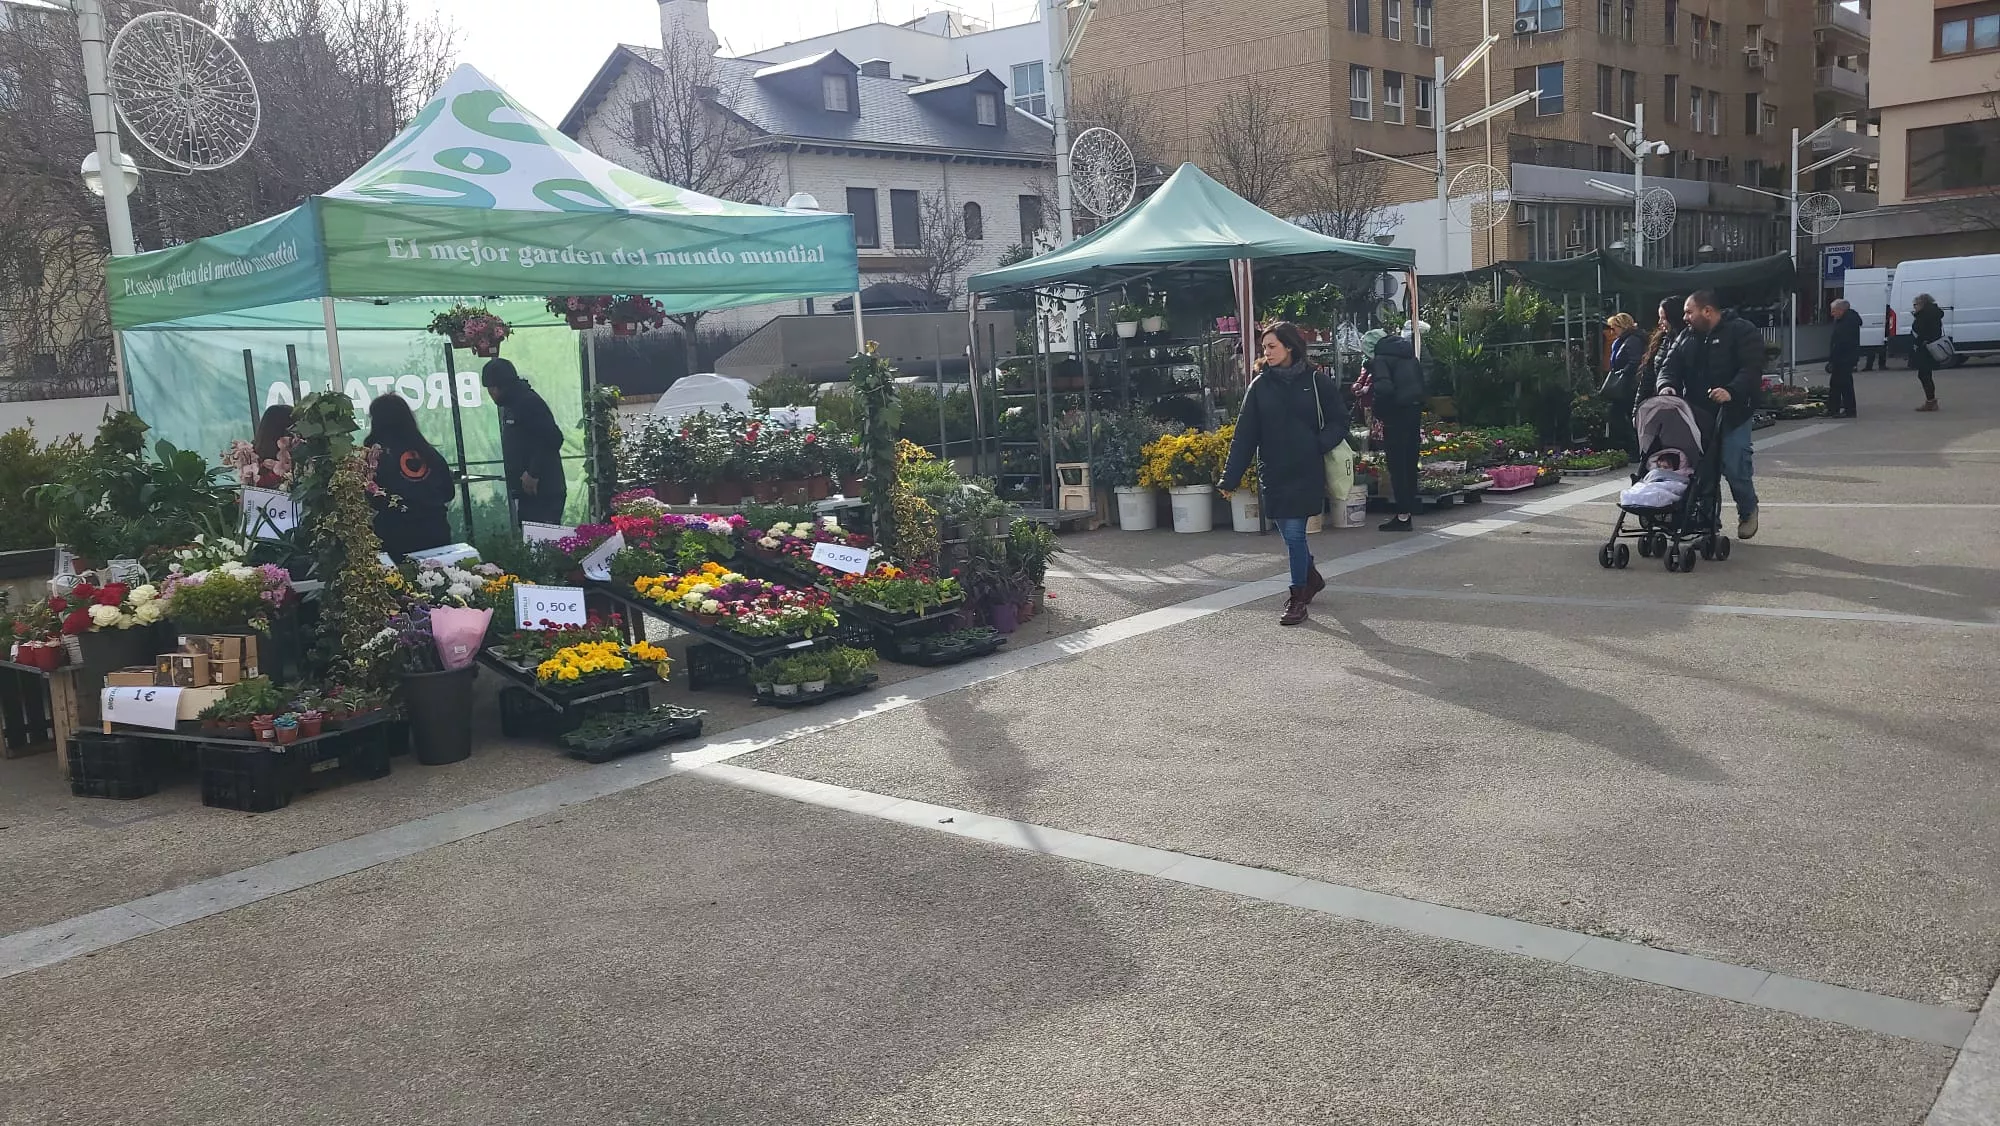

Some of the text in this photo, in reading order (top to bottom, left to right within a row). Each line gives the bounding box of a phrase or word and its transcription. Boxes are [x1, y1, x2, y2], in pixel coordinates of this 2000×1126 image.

[386, 237, 825, 268] El mejor garden del mundo mundial
[1827, 255, 1843, 274] P
[123, 238, 299, 298] El mejor garden del mundo mundial
[536, 601, 577, 613] 0,50€
